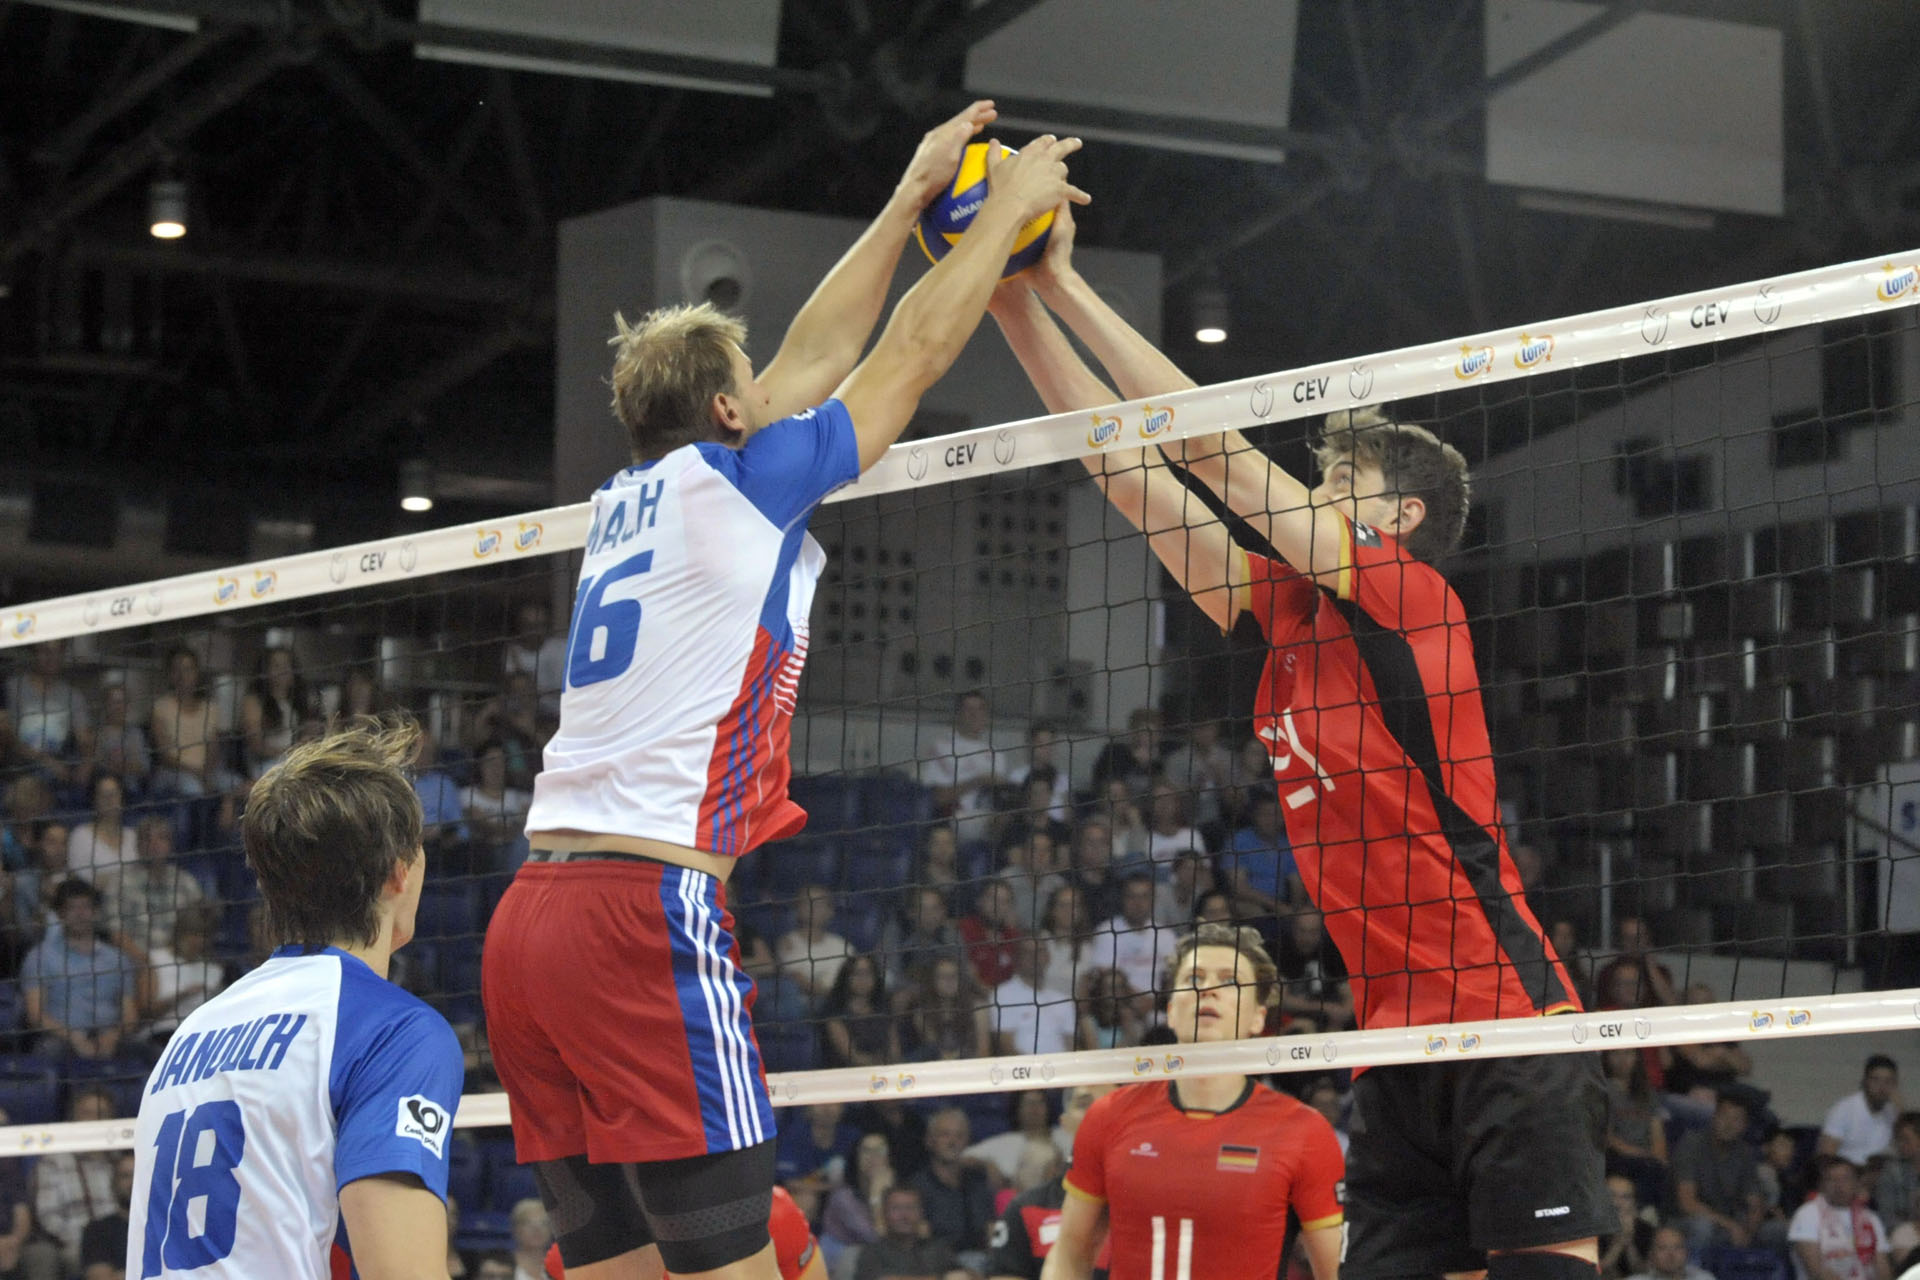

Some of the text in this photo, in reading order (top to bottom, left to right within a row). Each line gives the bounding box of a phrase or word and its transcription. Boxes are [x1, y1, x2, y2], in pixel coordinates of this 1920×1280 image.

[1690, 302, 1730, 329] CEV
[1293, 376, 1330, 404] CEV
[944, 441, 977, 468] CEV
[360, 551, 387, 572] CEV
[110, 597, 136, 616] CEV
[1599, 1022, 1623, 1038] CEV
[151, 1013, 308, 1095] JANOUCH
[1290, 1046, 1312, 1060] CEV
[1012, 1067, 1031, 1080] CEV
[142, 1100, 246, 1280] 18
[1151, 1216, 1193, 1280] 11
